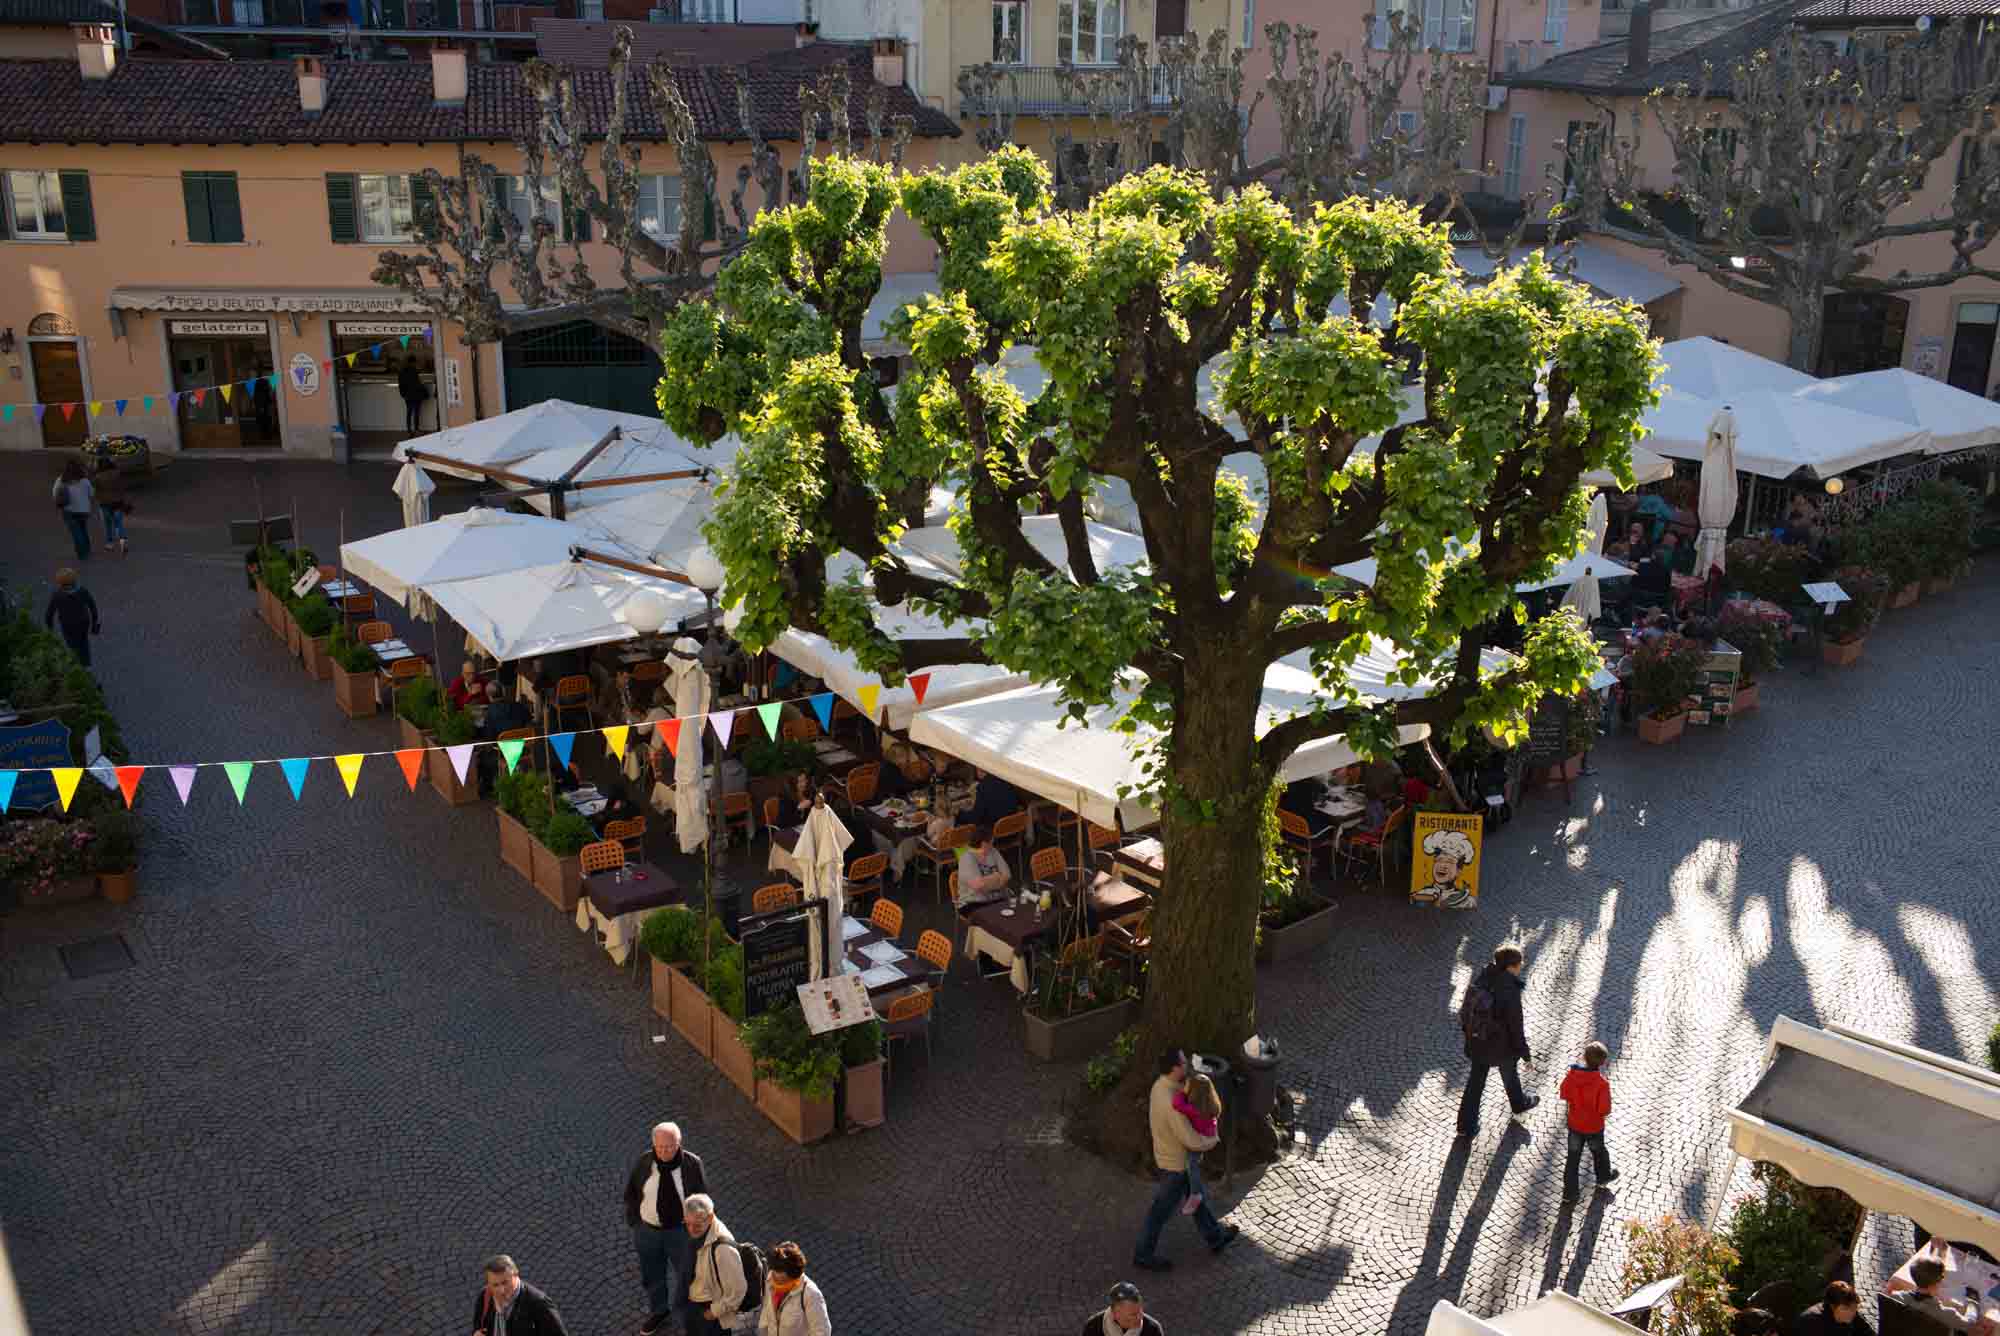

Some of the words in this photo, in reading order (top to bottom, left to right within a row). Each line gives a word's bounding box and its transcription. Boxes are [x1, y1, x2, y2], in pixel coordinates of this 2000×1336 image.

[176, 296, 201, 306] FIOR
[207, 297, 218, 307] DI
[223, 297, 264, 307] GELATO
[303, 297, 343, 309] GELATO
[344, 297, 393, 309] ITALIANO
[182, 321, 259, 332] gelateria
[1419, 817, 1479, 831] RISTORANTE
